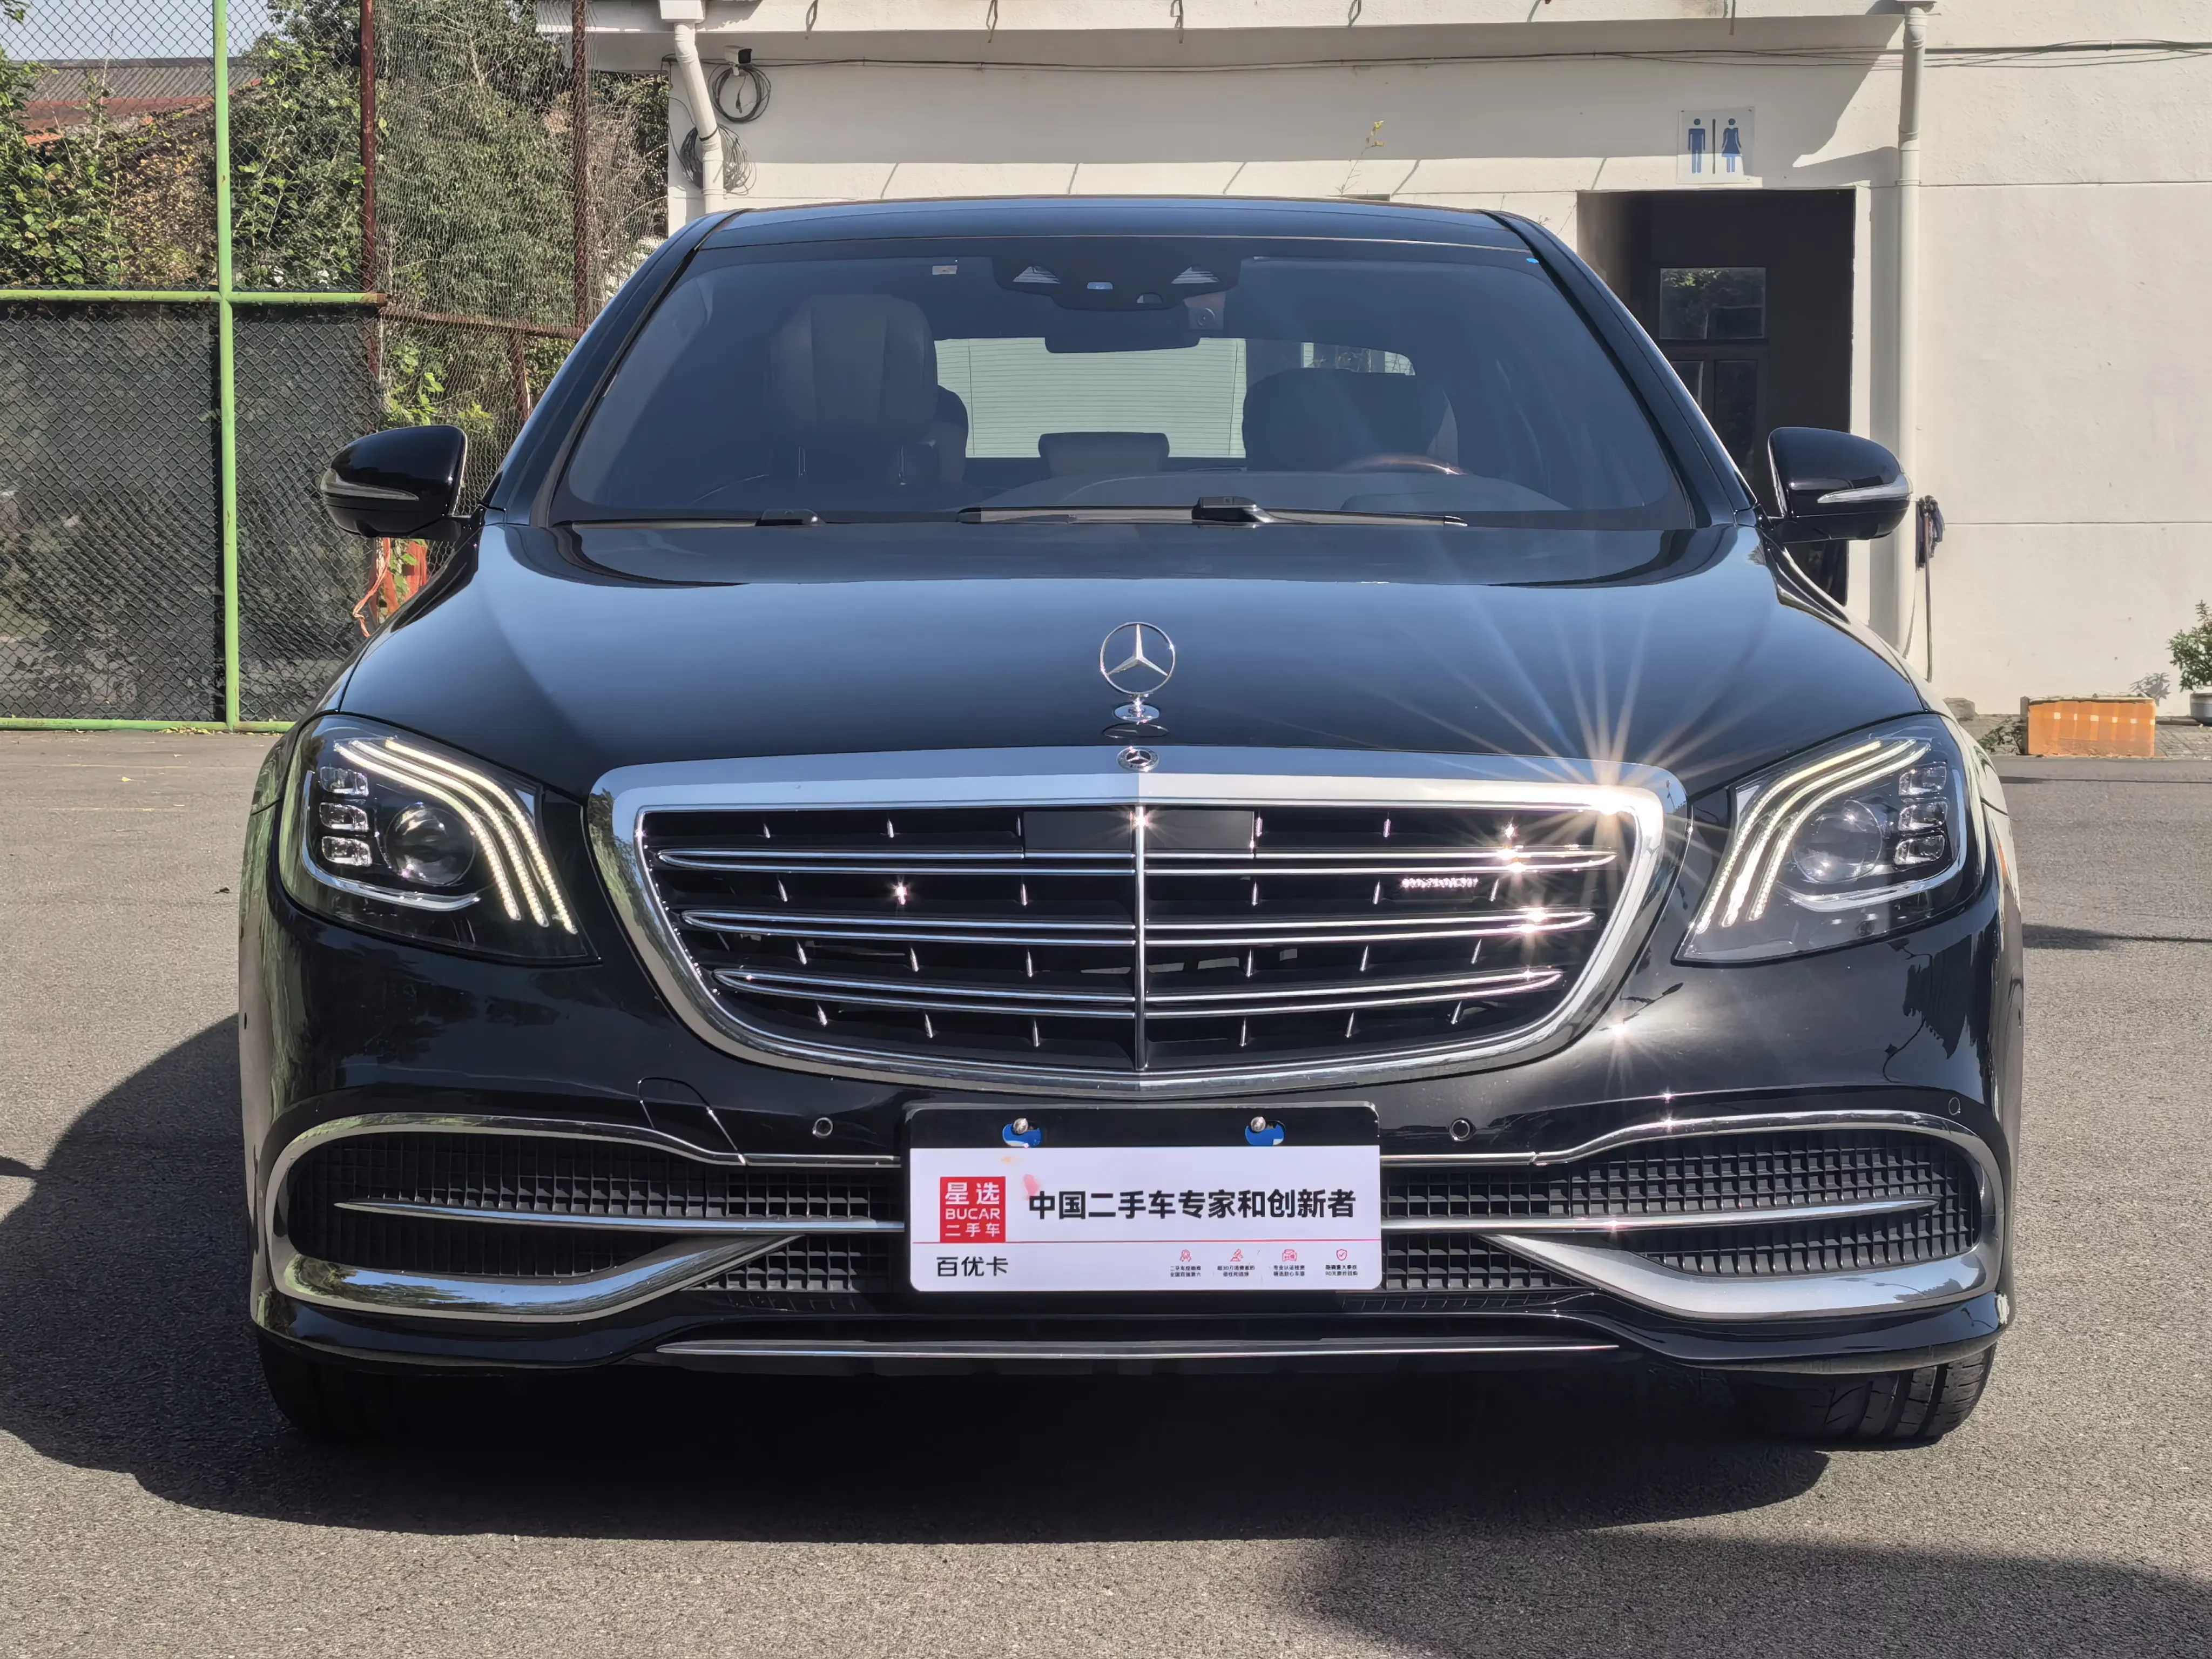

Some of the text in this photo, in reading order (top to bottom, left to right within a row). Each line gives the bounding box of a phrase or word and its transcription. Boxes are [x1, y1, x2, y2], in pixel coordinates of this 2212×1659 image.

[945, 1182, 1000, 1205] 星选
[945, 1208, 1000, 1220] BUCAR
[1029, 1189, 1356, 1220] 中国二手车专家和创新者
[945, 1223, 1000, 1237] 二手车
[936, 1256, 1008, 1277] 百优卡
